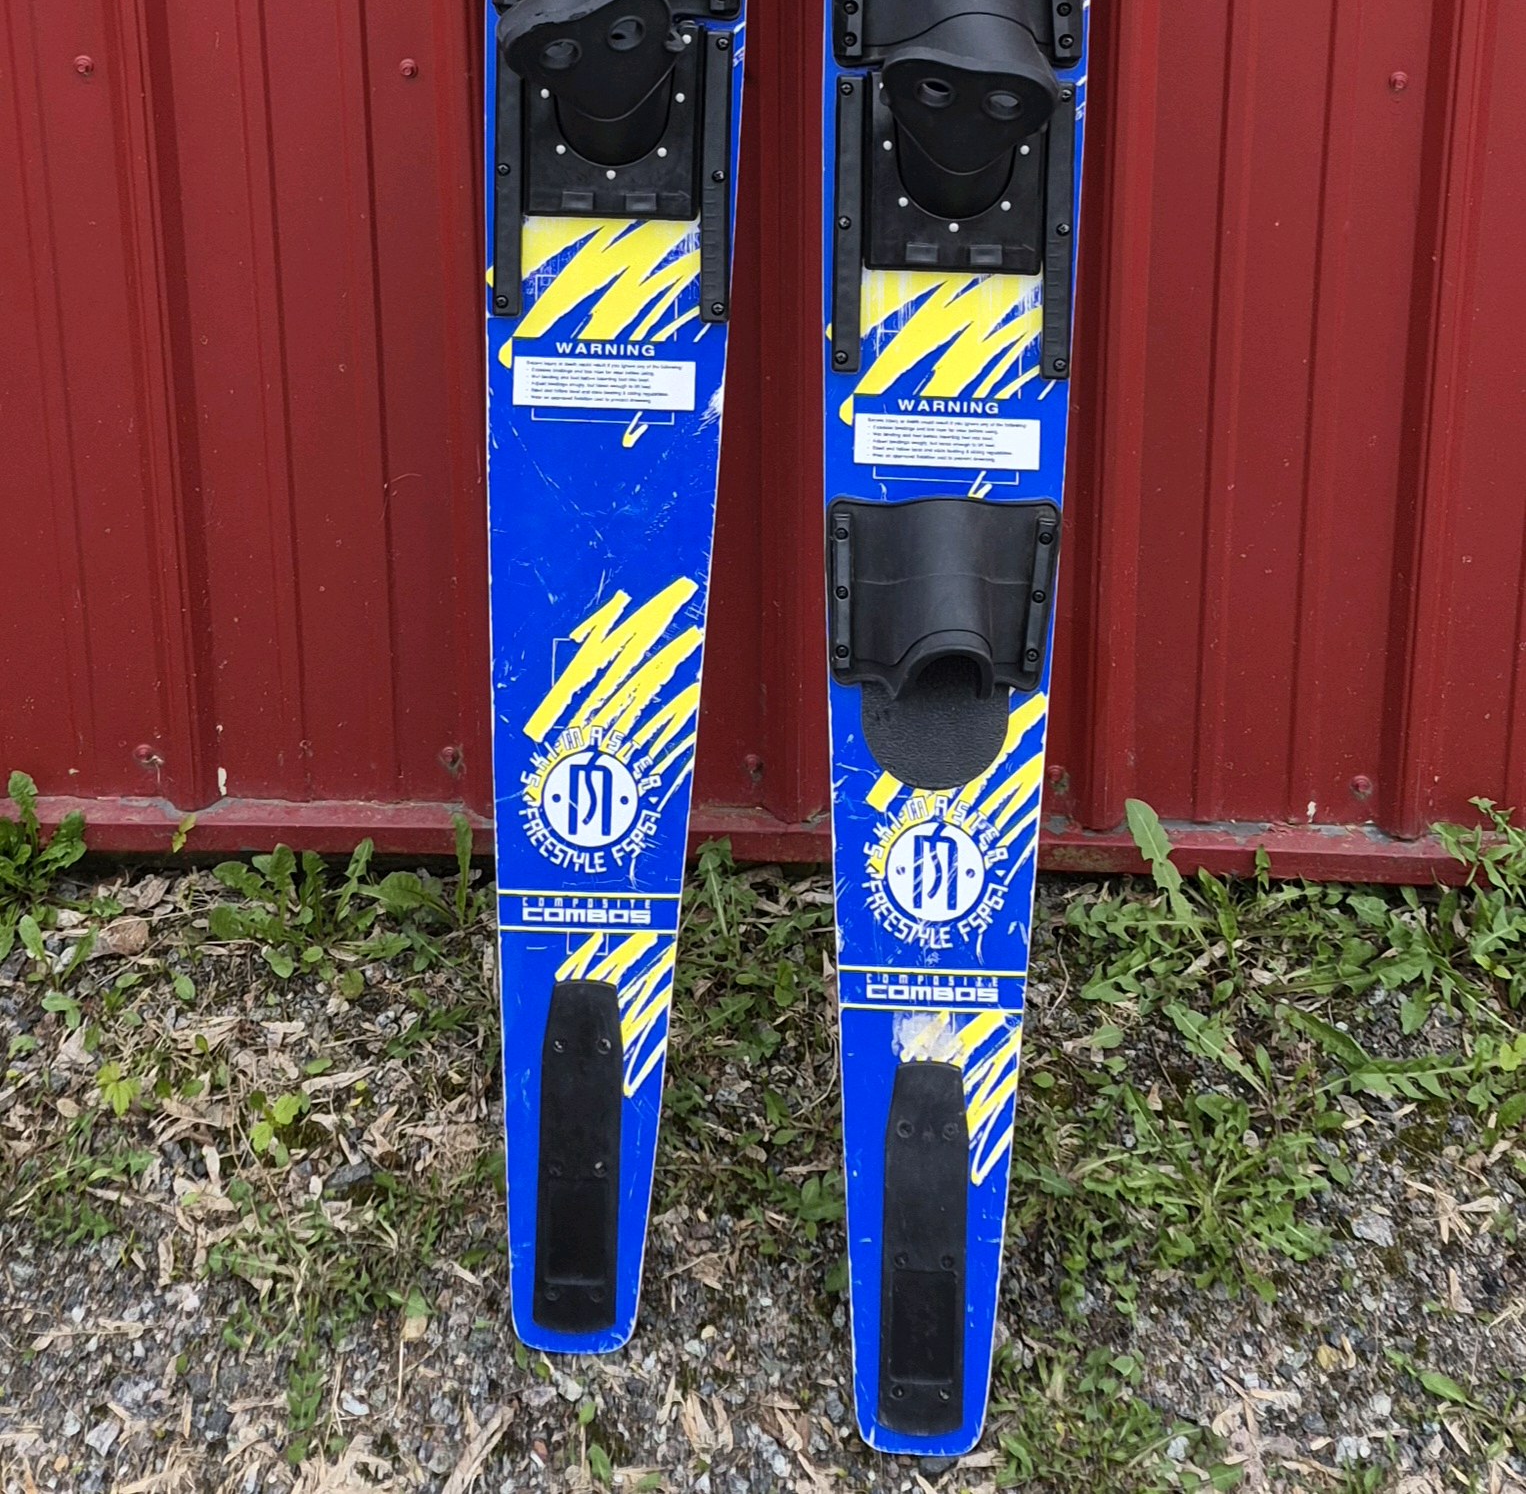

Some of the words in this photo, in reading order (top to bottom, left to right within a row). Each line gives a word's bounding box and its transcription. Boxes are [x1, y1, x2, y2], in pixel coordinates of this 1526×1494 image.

[556, 342, 656, 356] WARNING
[898, 399, 999, 414] WARNING
[518, 807, 607, 873] FREESTYLE
[522, 897, 651, 909] COMPOSITE
[522, 908, 651, 925] COMBOS
[862, 878, 953, 949] FREESTYLE
[866, 974, 999, 986] COMPOSITE
[866, 984, 999, 1003] COMBOS
